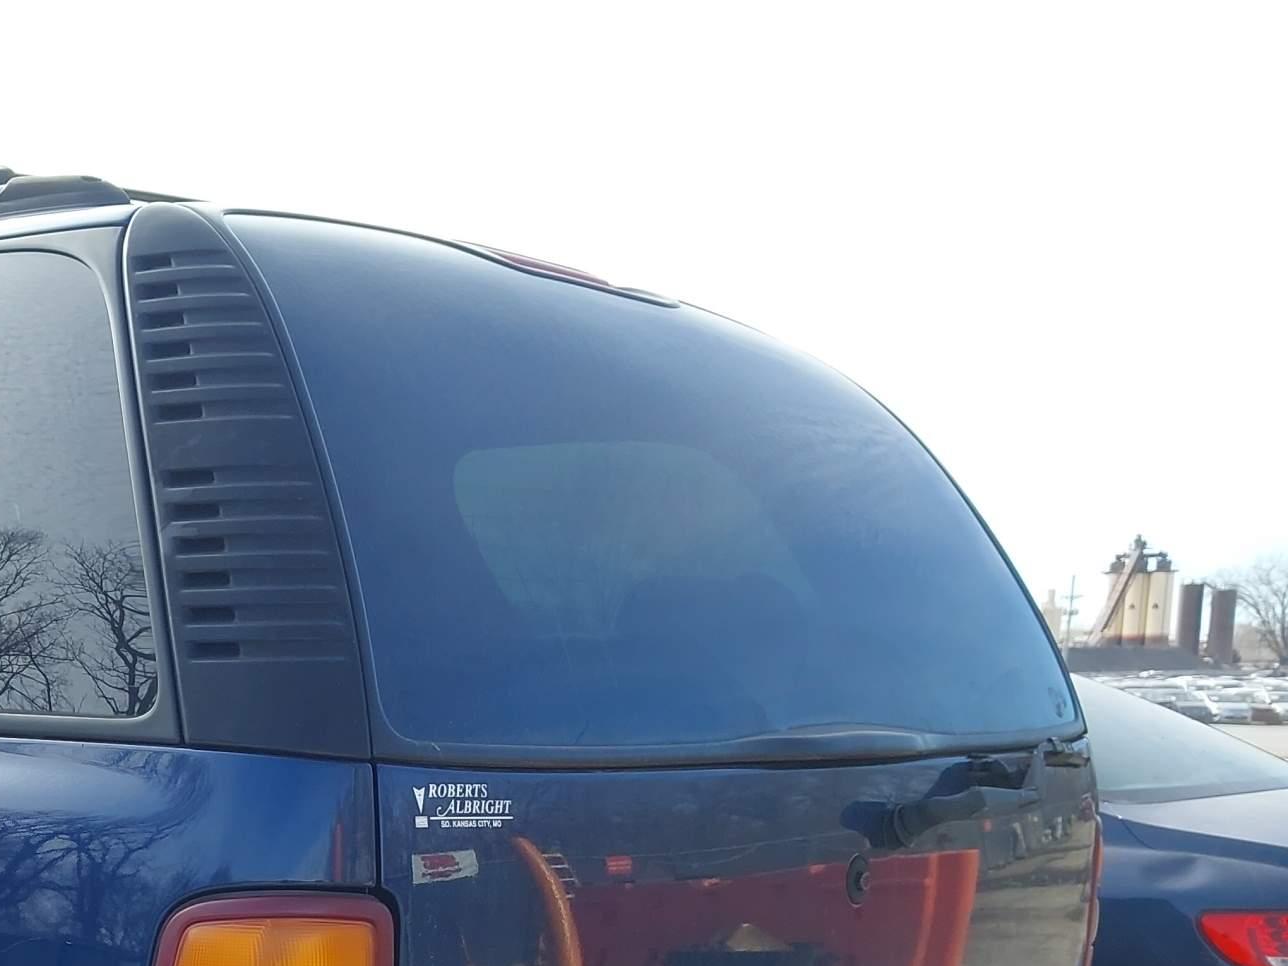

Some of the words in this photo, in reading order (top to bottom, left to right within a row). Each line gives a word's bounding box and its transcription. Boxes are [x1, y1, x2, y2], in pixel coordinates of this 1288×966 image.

[428, 783, 488, 799] ROBERTS
[436, 799, 512, 817] ALBRIGHT
[452, 820, 477, 828] KANSAS
